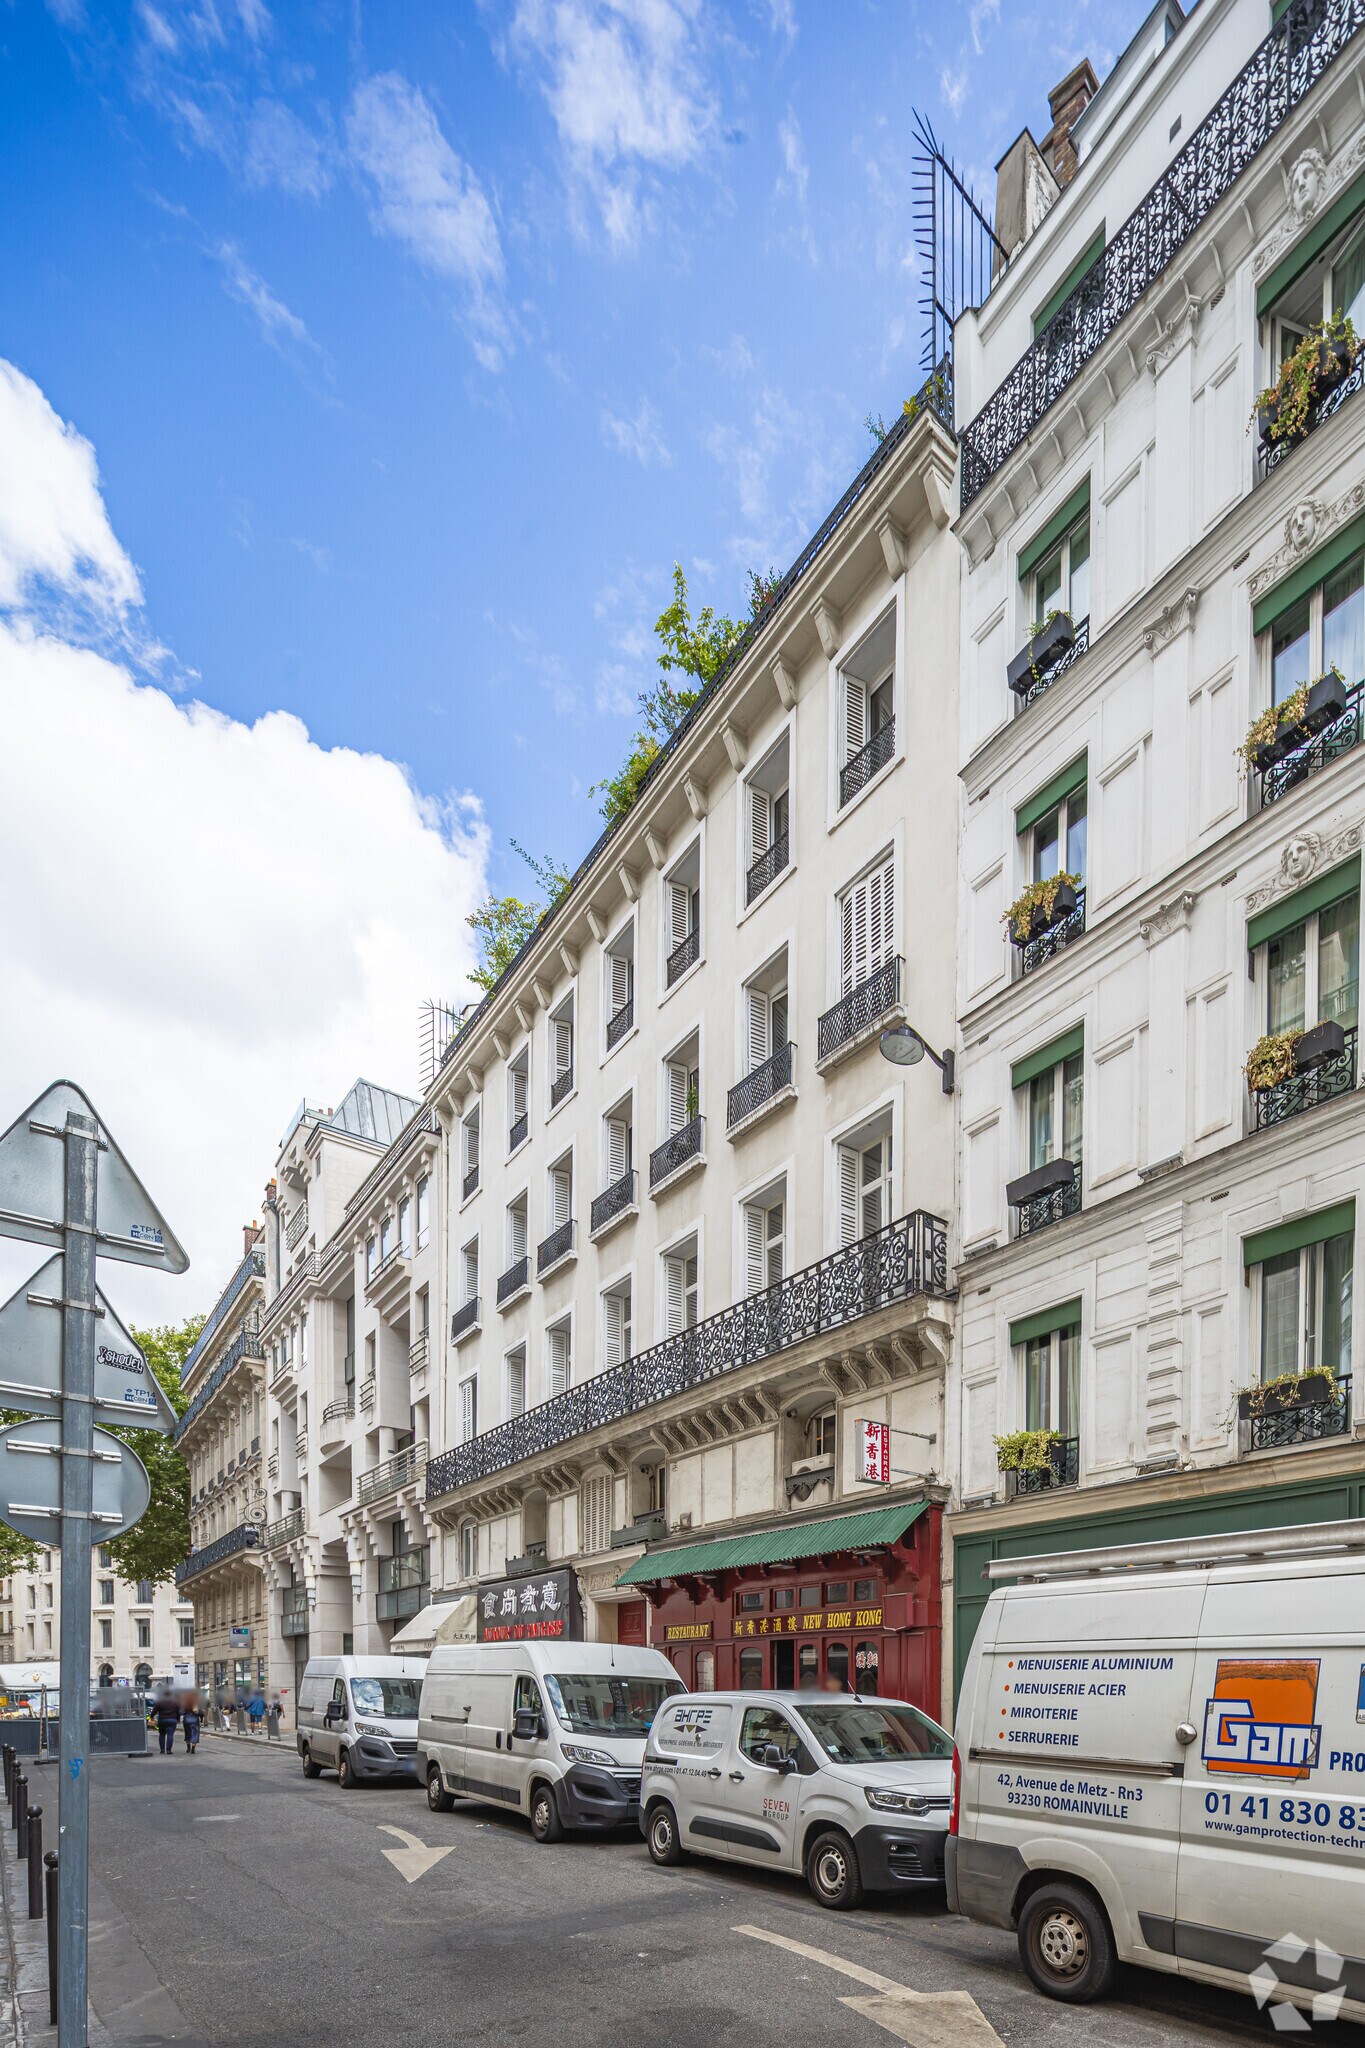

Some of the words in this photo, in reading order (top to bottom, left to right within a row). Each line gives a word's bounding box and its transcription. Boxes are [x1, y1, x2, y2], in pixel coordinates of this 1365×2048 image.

[140, 1225, 162, 1236] TP14
[134, 1389, 156, 1398] TP14
[865, 1423, 880, 1480] 新香港
[803, 1614, 823, 1629] NEW
[827, 1612, 852, 1628] HONG
[855, 1609, 882, 1626] KONG
[667, 1624, 709, 1640] RESTAURANT
[1017, 1659, 1089, 1671] MENUISERIE
[1091, 1657, 1174, 1671] ALUMINIUM
[1013, 1683, 1085, 1696] MENUISERIE
[1087, 1683, 1126, 1696] ACIER
[1010, 1706, 1078, 1721] MIROITERIE
[1008, 1731, 1079, 1746] SERRURERIE
[1329, 1751, 1365, 1772] PRO
[997, 1773, 1014, 1788] 42,
[1016, 1775, 1058, 1792] Avenue
[1060, 1778, 1076, 1793] de
[1078, 1780, 1107, 1797] Metz
[1118, 1786, 1143, 1802] Rn3
[763, 1798, 790, 1812] SEVEN
[1007, 1791, 1041, 1808] 93230
[1043, 1796, 1128, 1819] ROMAINVILLE
[1205, 1791, 1232, 1815] 01
[1240, 1796, 1269, 1820] 41
[1279, 1799, 1330, 1827] 830
[768, 1811, 789, 1821] GROUP
